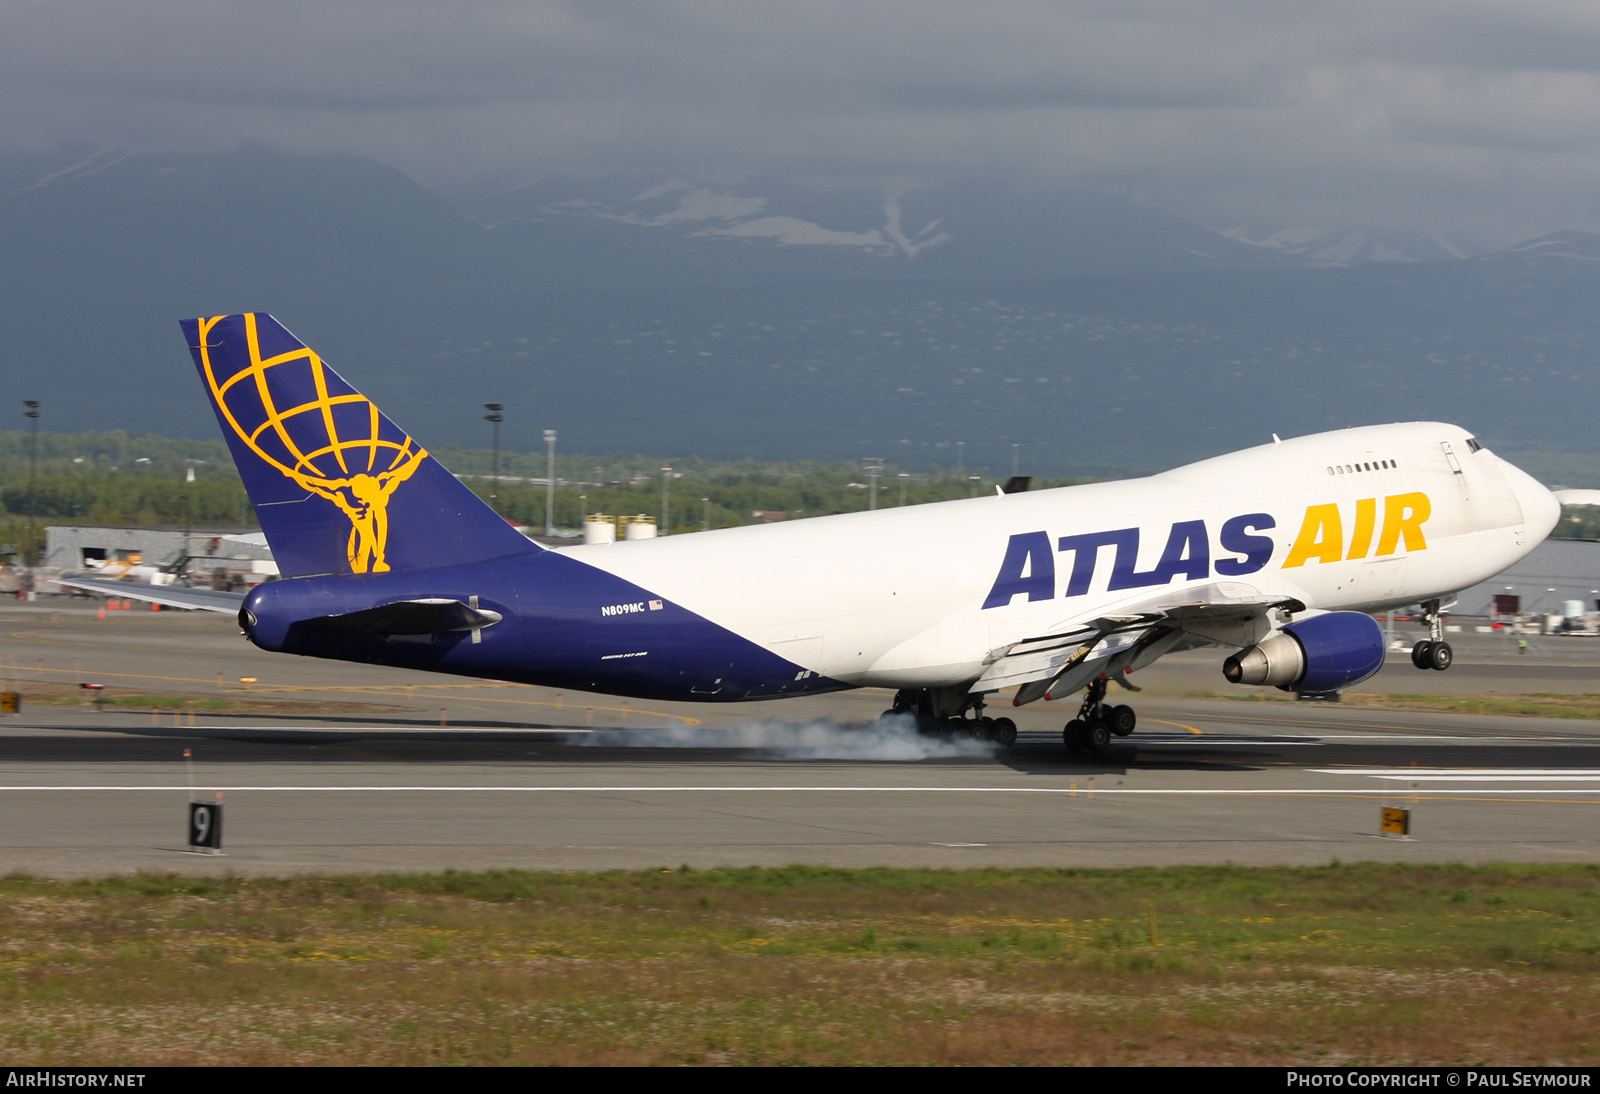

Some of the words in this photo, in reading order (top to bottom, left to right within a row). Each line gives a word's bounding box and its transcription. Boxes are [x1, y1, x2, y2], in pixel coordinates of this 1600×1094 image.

[980, 512, 1276, 610] ATLAS
[1280, 491, 1432, 569] AIR
[601, 602, 645, 616] N809MC
[194, 807, 210, 843] 9
